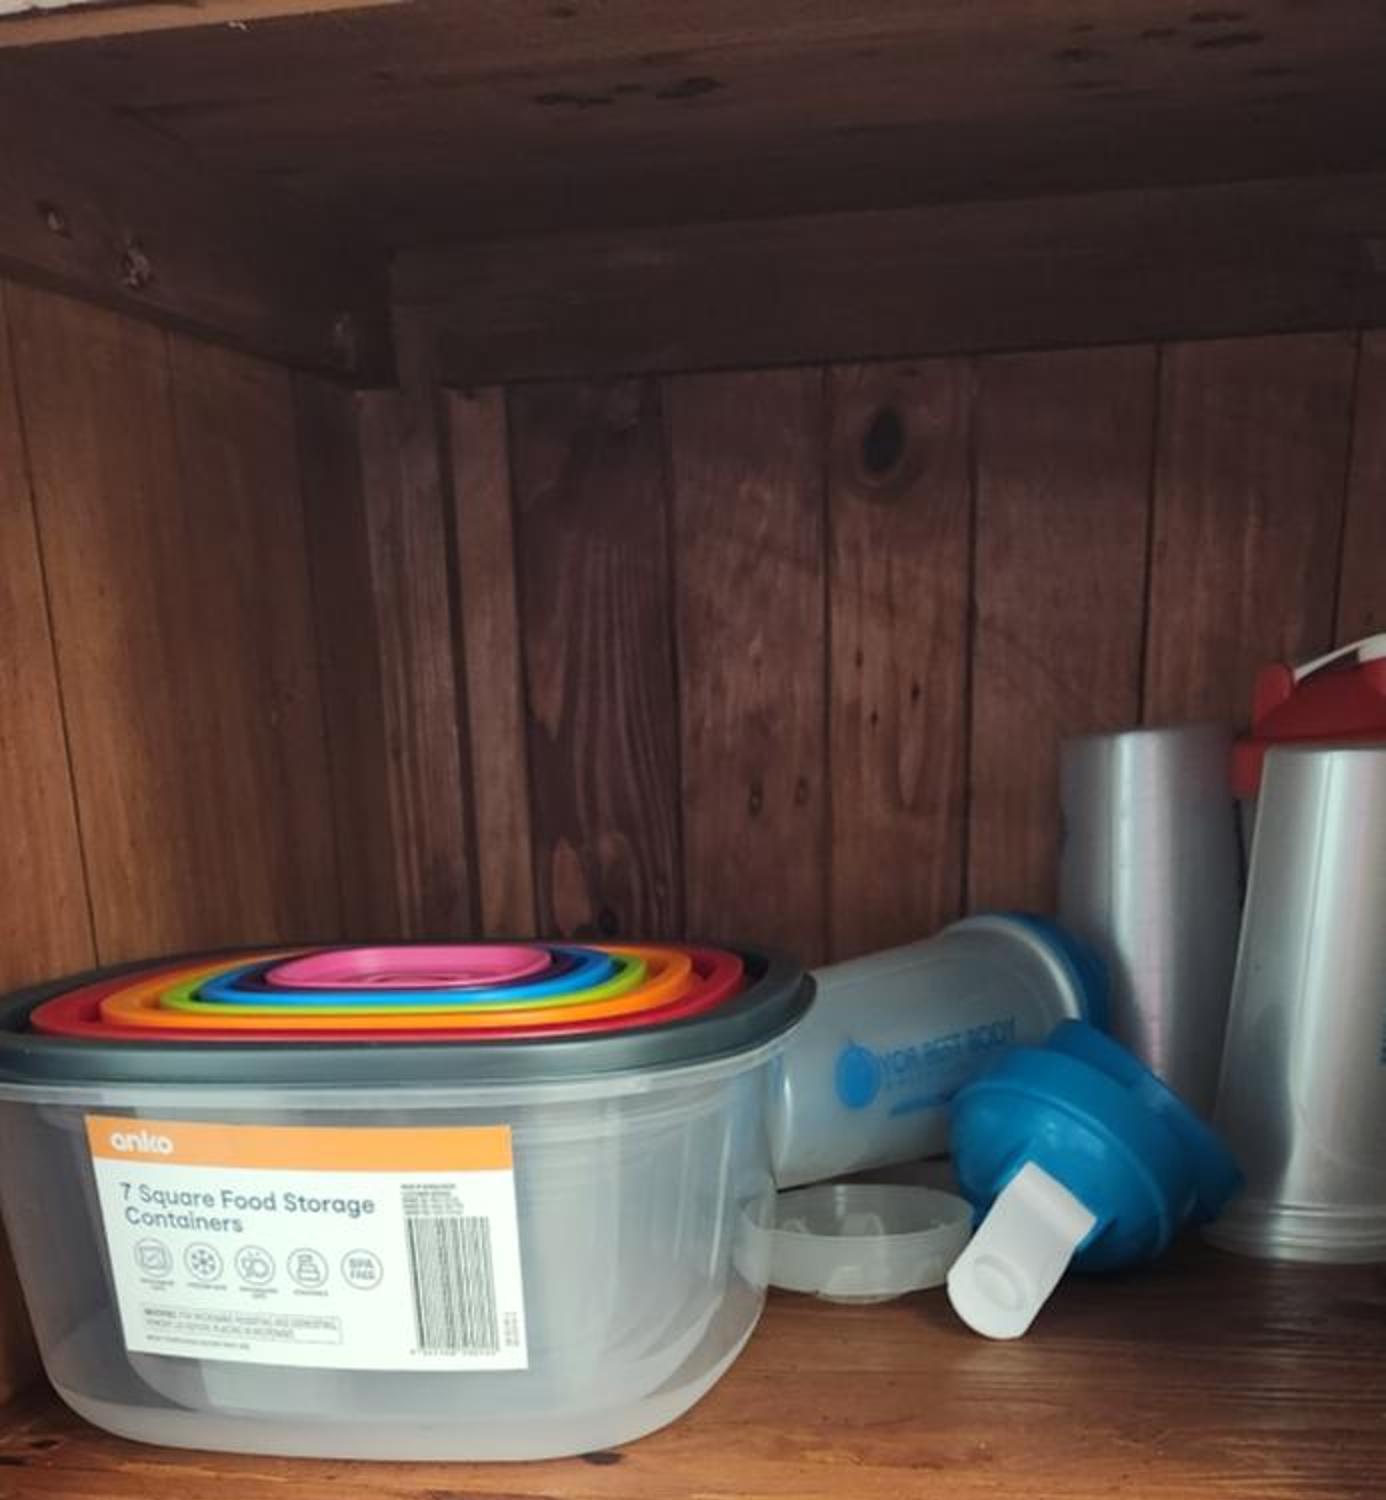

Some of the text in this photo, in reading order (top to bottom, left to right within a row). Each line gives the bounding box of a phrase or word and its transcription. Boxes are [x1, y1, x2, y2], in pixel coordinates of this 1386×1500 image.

[110, 1129, 174, 1155] anko
[120, 1182, 376, 1219] 7 Square Food Storage
[124, 1206, 244, 1233] Containers
